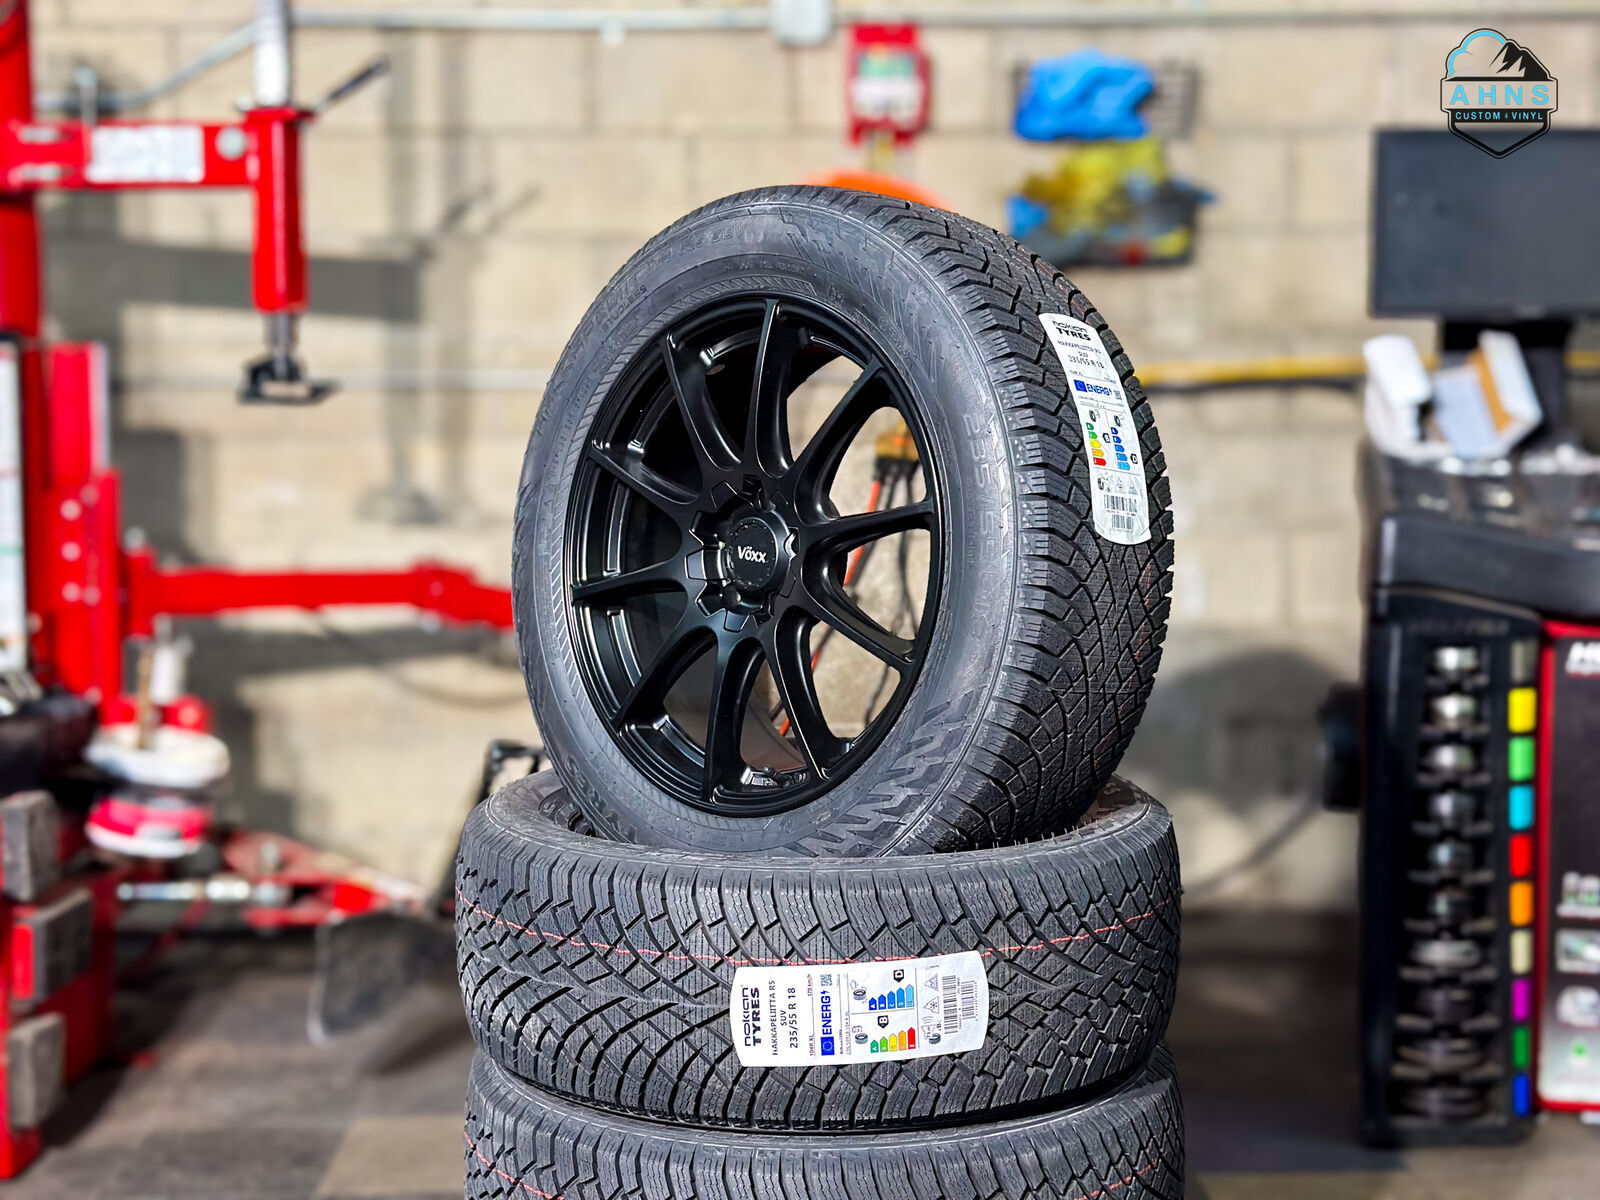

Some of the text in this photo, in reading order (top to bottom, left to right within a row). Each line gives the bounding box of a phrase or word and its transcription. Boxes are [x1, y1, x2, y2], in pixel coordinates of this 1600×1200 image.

[1055, 327, 1091, 341] TYRES
[787, 987, 797, 1000] 18
[750, 987, 762, 1047] TYRES
[769, 992, 779, 1056] HAKKAPELIITTA
[780, 1009, 788, 1027] SUV
[788, 1013, 799, 1049] 235/55
